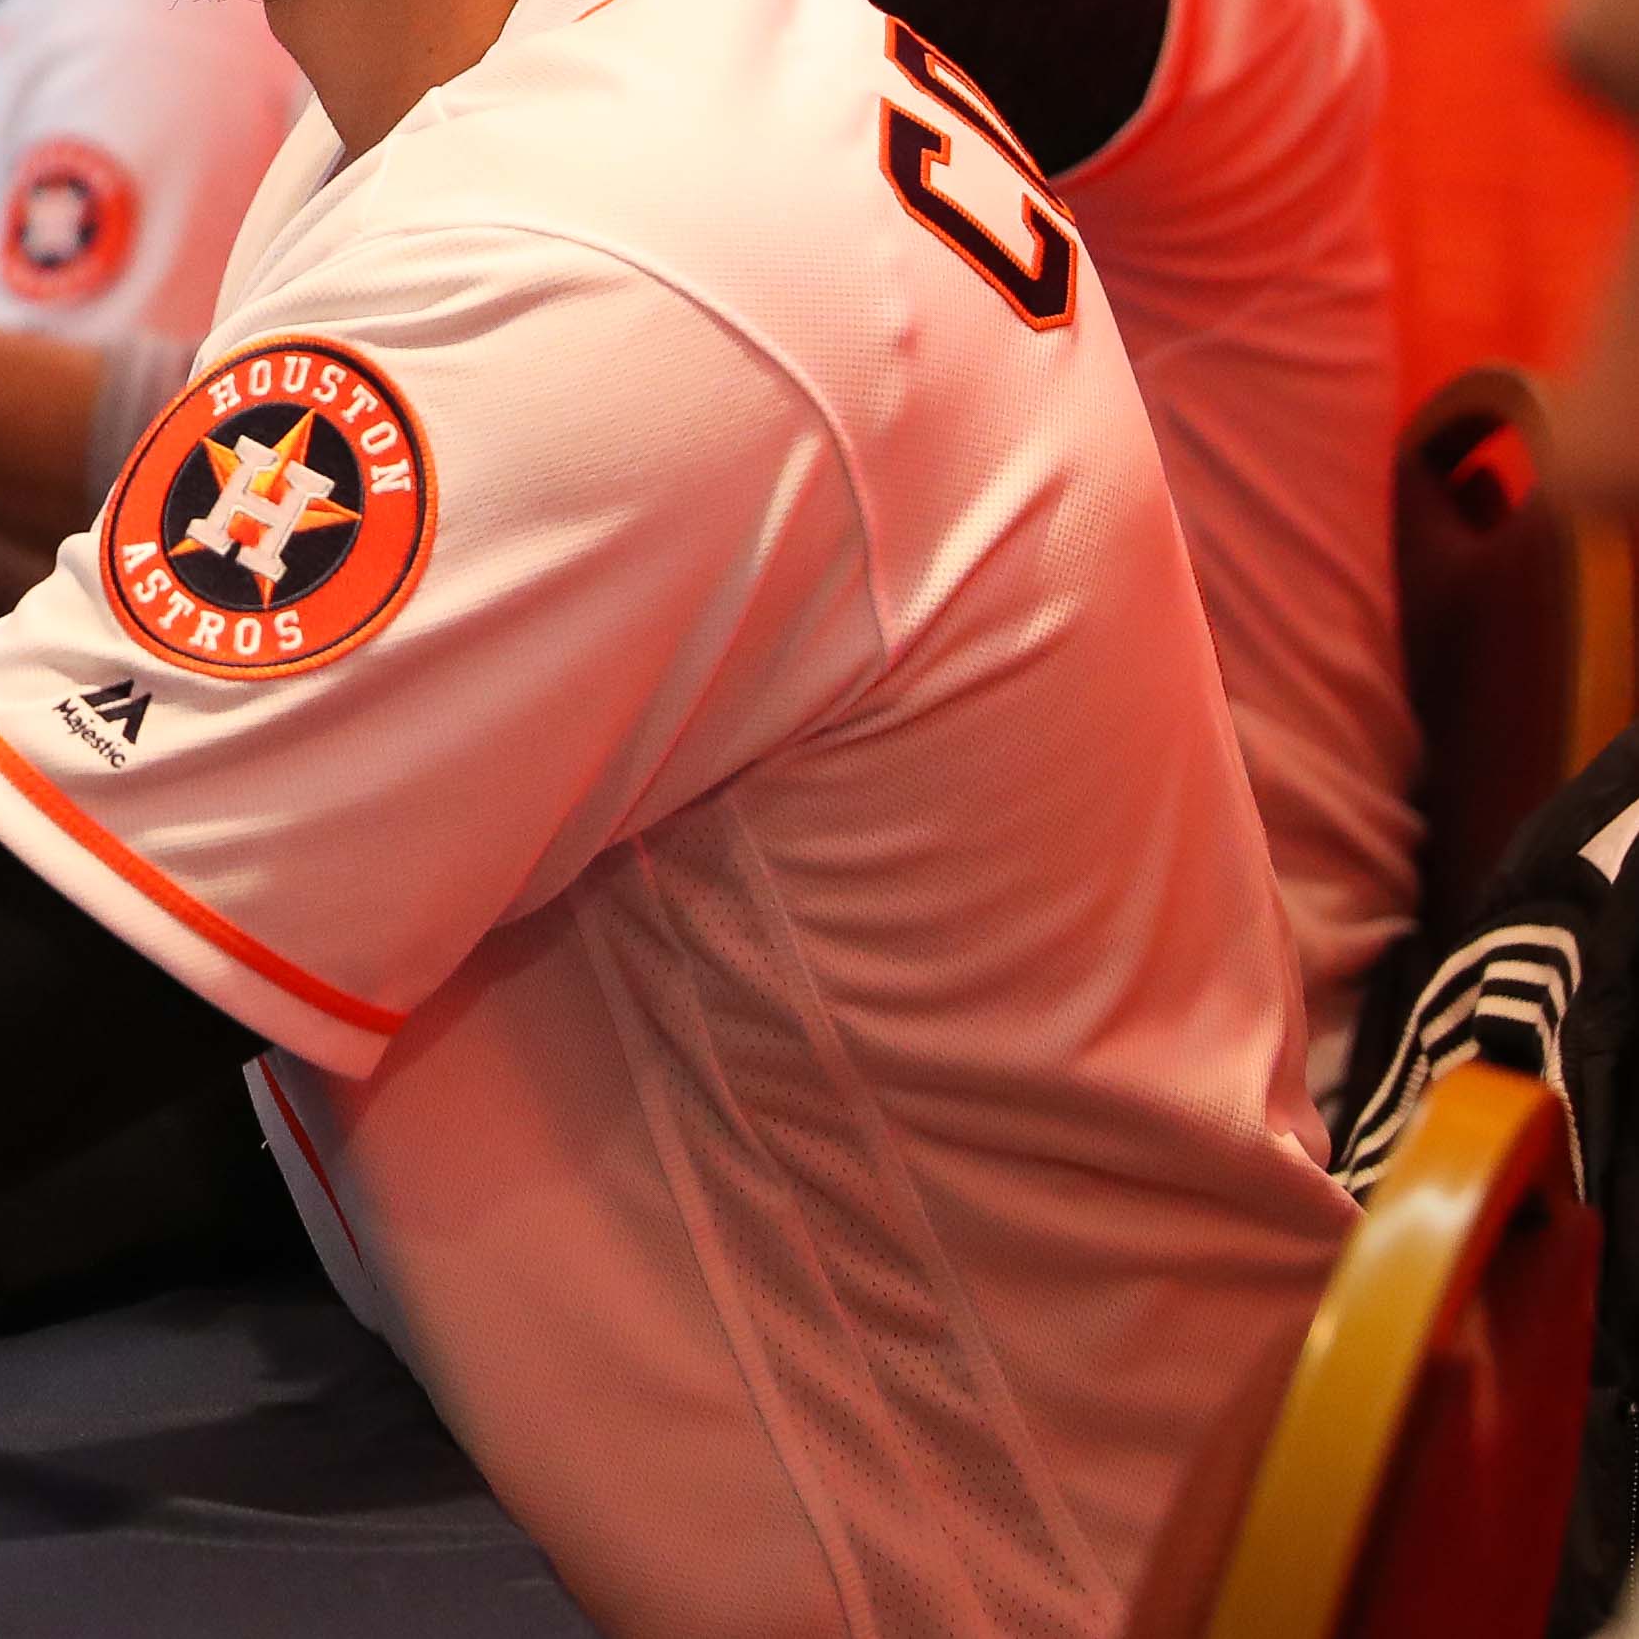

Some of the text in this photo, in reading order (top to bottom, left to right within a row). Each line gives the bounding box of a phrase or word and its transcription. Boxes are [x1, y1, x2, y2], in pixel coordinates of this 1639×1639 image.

[207, 356, 412, 495] HOUSTON
[185, 435, 335, 583] H
[122, 540, 303, 655] ASTROS
[51, 698, 126, 769] Majestic
